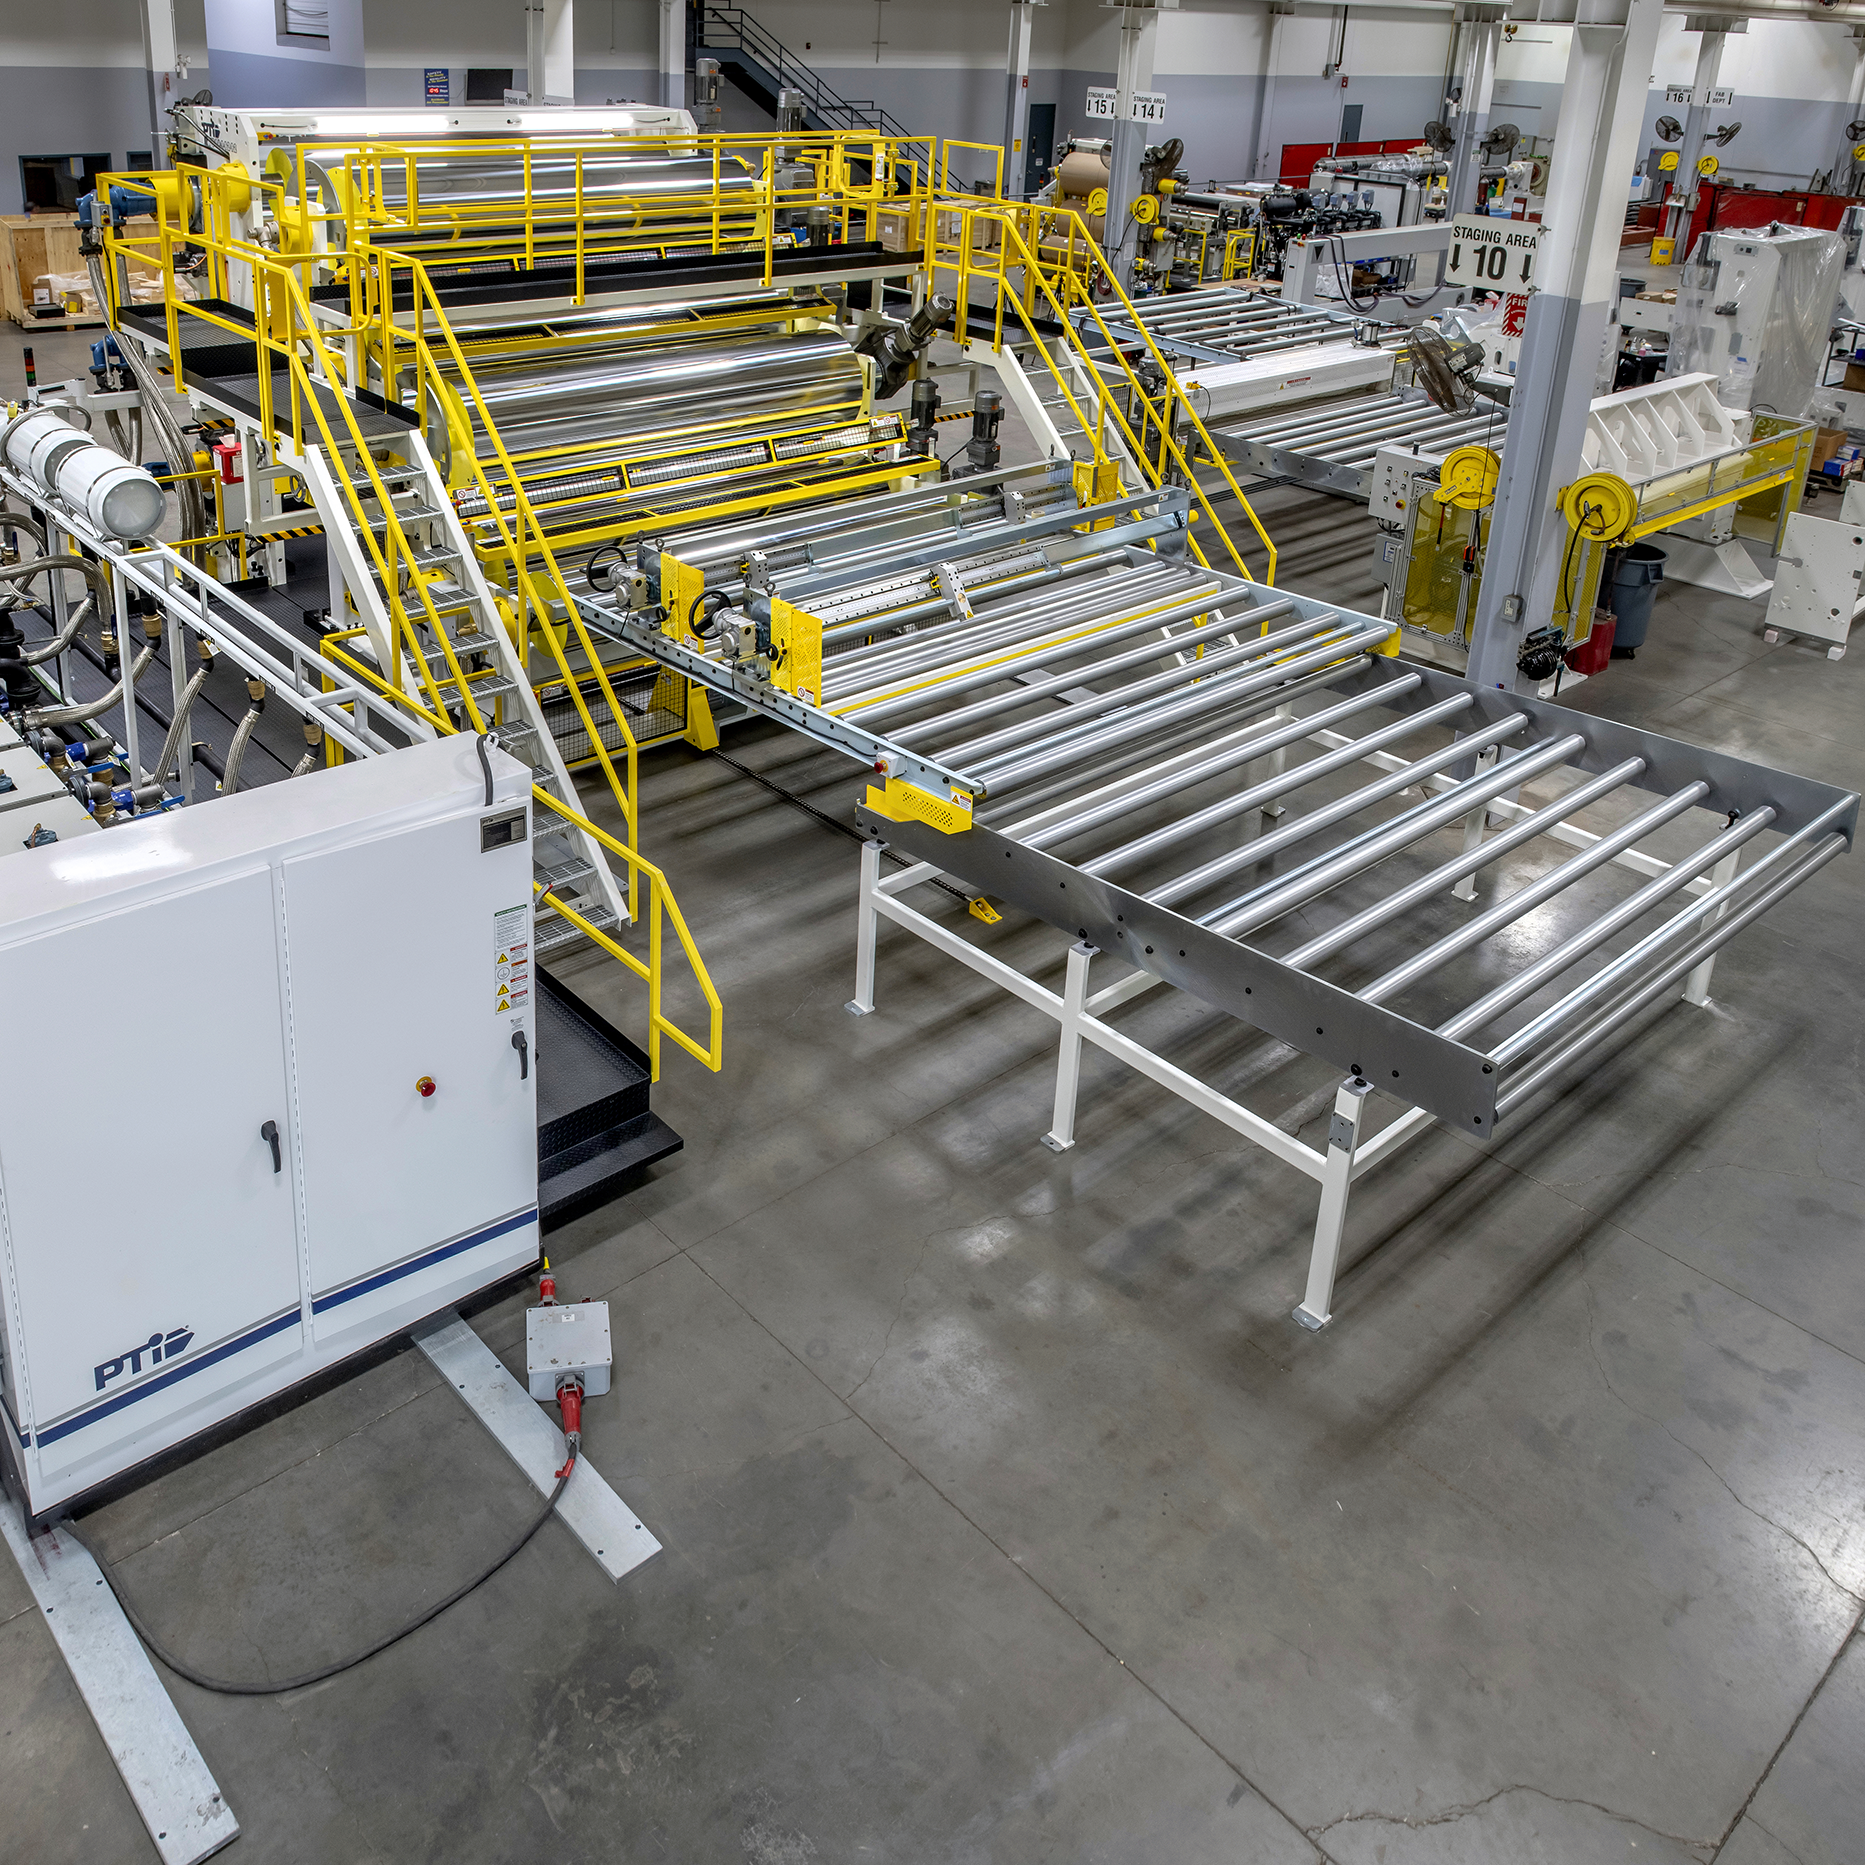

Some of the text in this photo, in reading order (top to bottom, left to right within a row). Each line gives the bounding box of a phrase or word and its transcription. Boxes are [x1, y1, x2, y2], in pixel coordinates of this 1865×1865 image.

[1673, 92, 1684, 103] 16
[1095, 99, 1107, 114] 15
[1141, 103, 1154, 119] 14
[1453, 225, 1537, 249] STAGING AREA
[1473, 244, 1508, 281] 10
